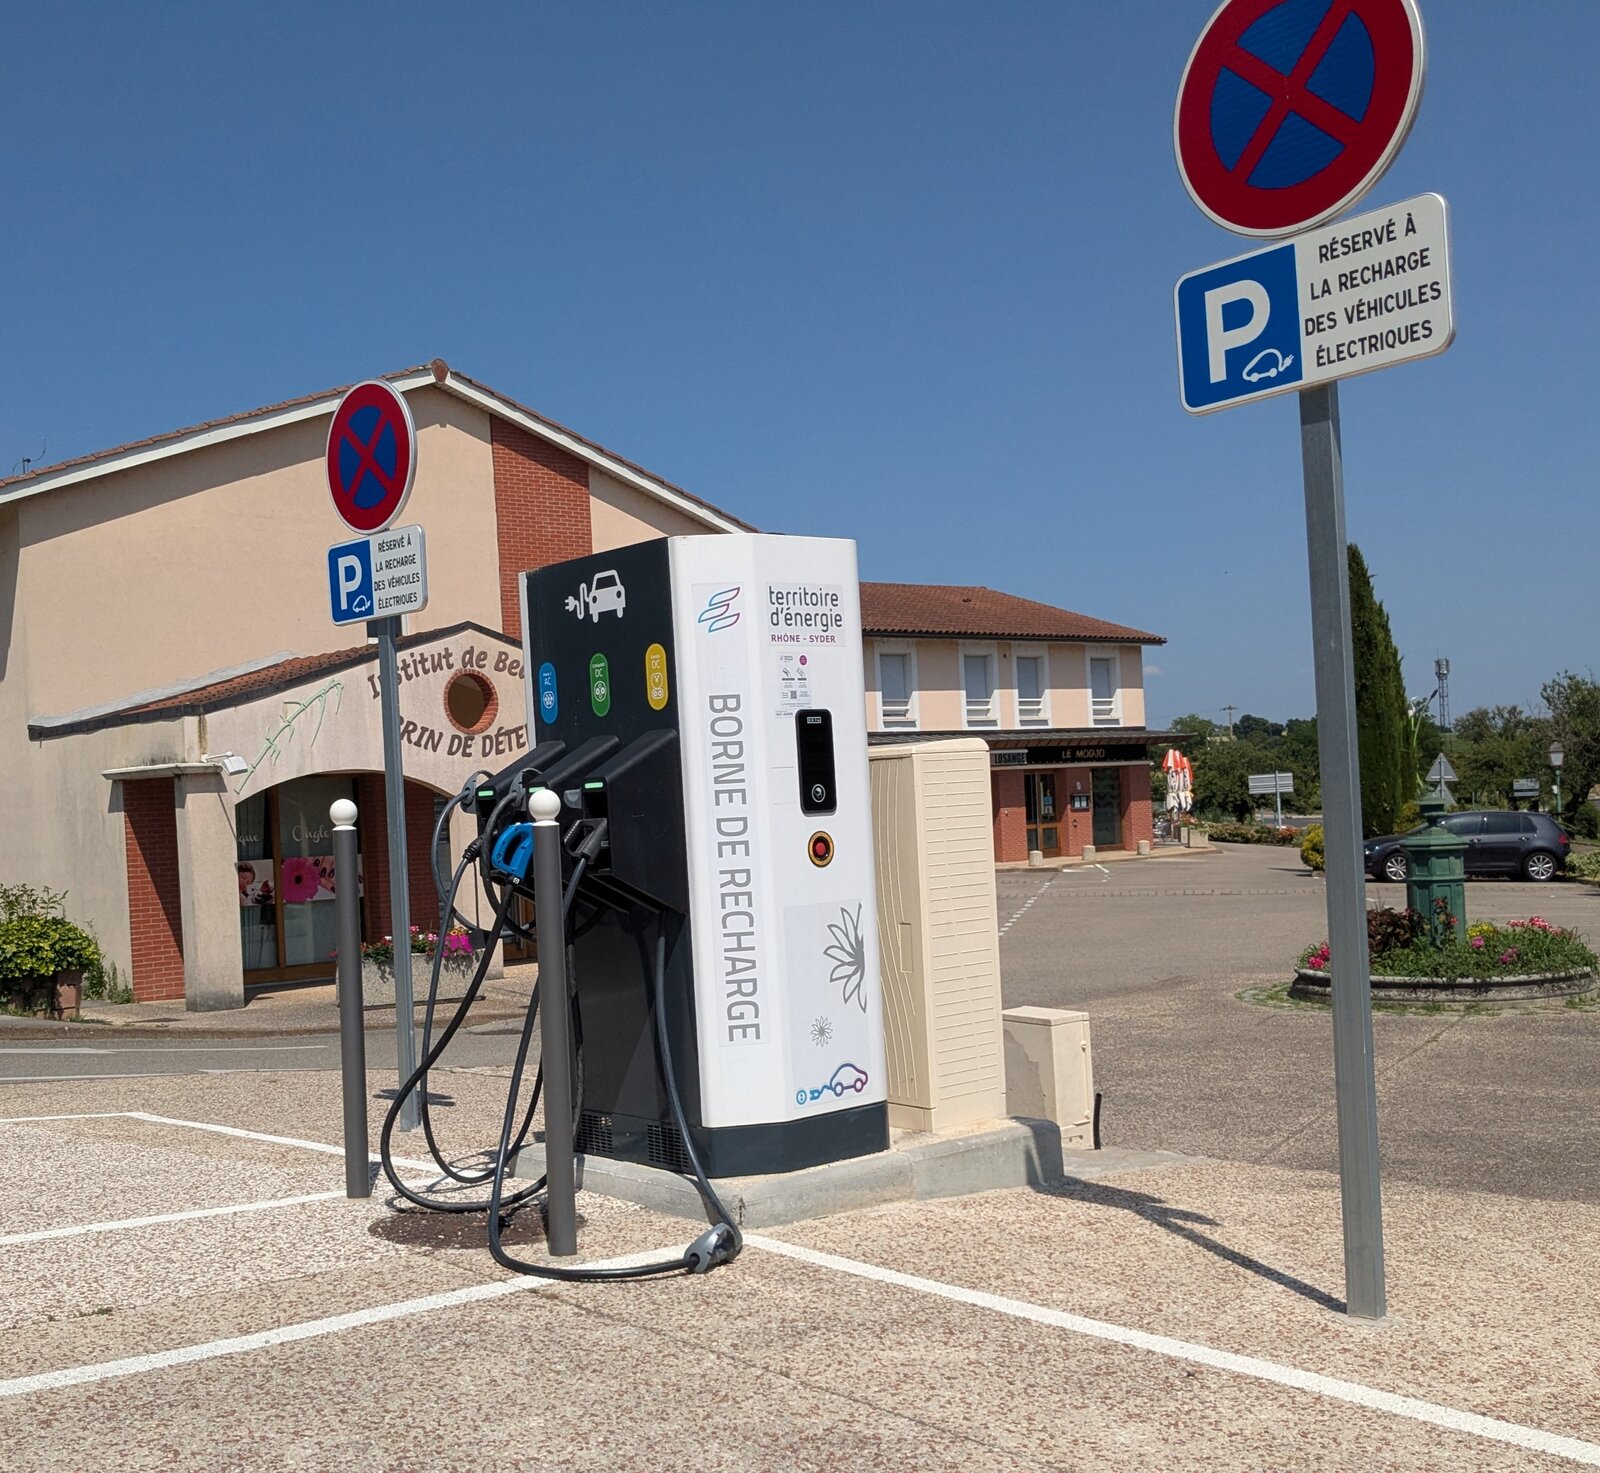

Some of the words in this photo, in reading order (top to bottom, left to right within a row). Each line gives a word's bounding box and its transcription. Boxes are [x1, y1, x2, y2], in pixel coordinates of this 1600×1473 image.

[1318, 218, 1397, 264] RÉSERVÉ
[1404, 212, 1417, 237] À
[1310, 278, 1332, 301] LA
[1338, 247, 1431, 292] RECHARGE
[1304, 311, 1337, 337] DES
[1343, 281, 1442, 325] VÉHICULES
[1204, 279, 1271, 384] P
[1316, 319, 1433, 368] ÉLECTRIQUES
[377, 535, 405, 554] RÉSERVÉ
[375, 562, 384, 573] LA
[385, 553, 417, 571] RECHARGE
[338, 555, 362, 611] P
[374, 580, 386, 592] DES
[387, 572, 420, 589] VÉHICULES
[769, 585, 839, 607] territoire
[378, 592, 418, 610] ÉLECTRIQUES
[770, 607, 843, 633] d'énergie
[771, 633, 801, 643] RHÔNE
[809, 634, 836, 644] SYDER
[367, 647, 455, 699] Ititut
[461, 646, 488, 669] de
[446, 734, 475, 758] DE
[481, 723, 528, 758] DÉTE
[708, 693, 747, 807] BORNE
[1062, 749, 1072, 759] LE
[994, 753, 1026, 764] LOSANGE
[238, 834, 260, 847] que
[292, 824, 331, 843] Ongle
[715, 816, 750, 859] DE
[718, 868, 761, 1042] RECHARGE
